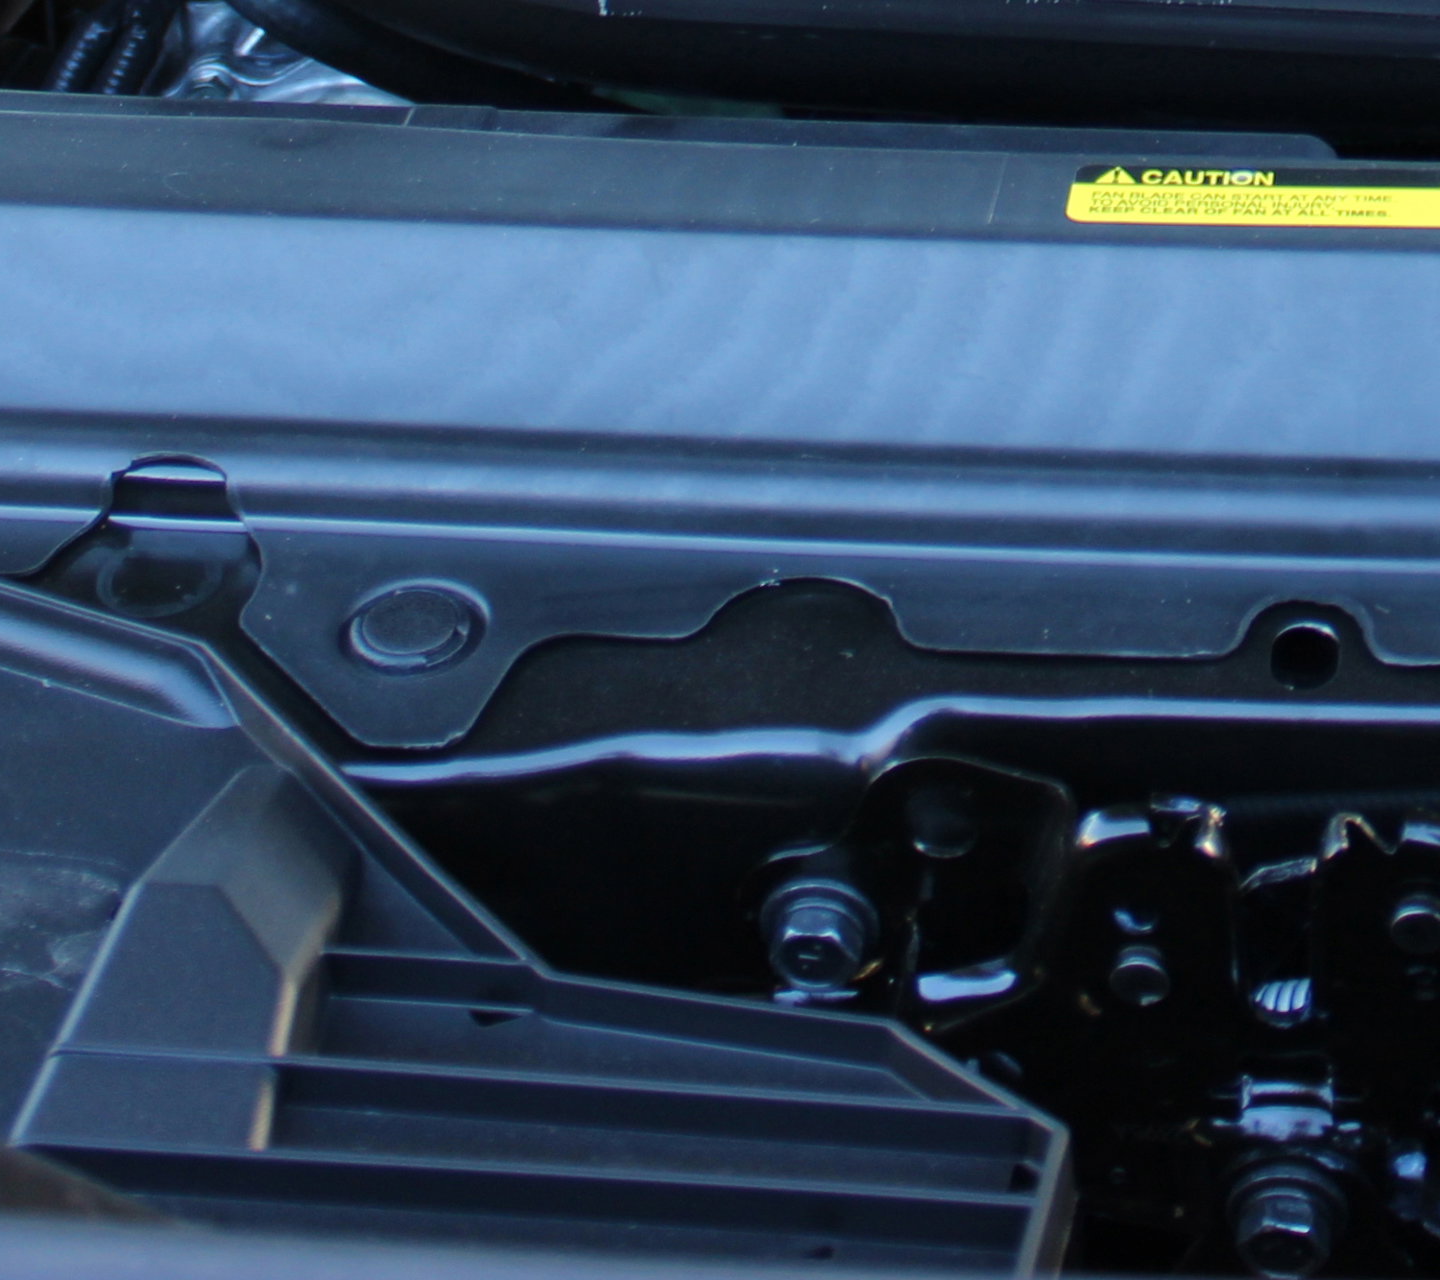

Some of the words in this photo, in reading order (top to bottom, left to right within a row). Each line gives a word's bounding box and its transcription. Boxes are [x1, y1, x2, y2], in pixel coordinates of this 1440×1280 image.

[1141, 168, 1275, 186] CAUTION
[1091, 191, 1125, 199] FAN
[1129, 192, 1184, 200] BLADE
[1189, 193, 1226, 201] CAN
[1231, 193, 1283, 202] START
[1290, 194, 1310, 202] AT
[1091, 199, 1113, 207] TO
[1116, 199, 1169, 207] AVOID
[1174, 200, 1263, 209] PERSONAL
[1139, 207, 1198, 215] CLEAR
[1232, 208, 1266, 216] FAN
